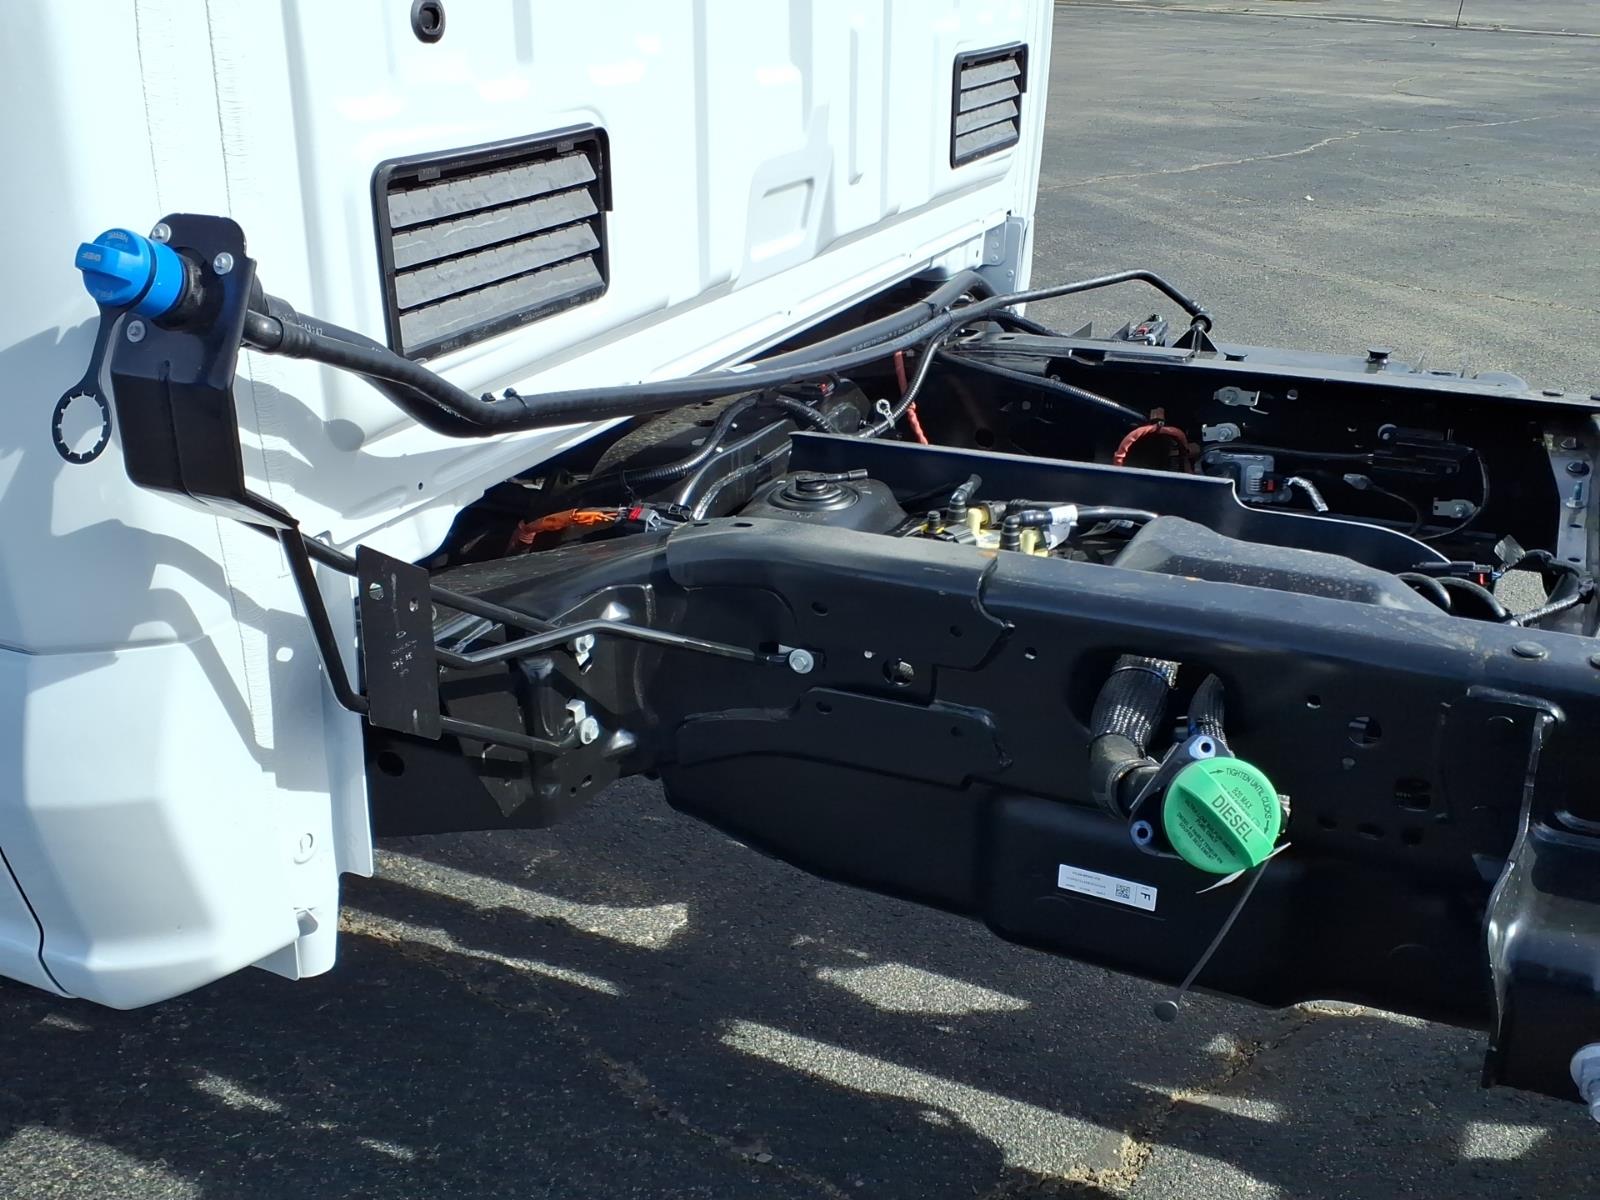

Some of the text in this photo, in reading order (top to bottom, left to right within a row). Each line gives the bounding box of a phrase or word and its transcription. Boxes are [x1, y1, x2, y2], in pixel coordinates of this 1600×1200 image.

[1211, 794, 1252, 842] DIESEL
[1226, 768, 1252, 784] TIGHTEN
[1249, 778, 1265, 797] UNTIL
[1260, 795, 1271, 819] CLICKS
